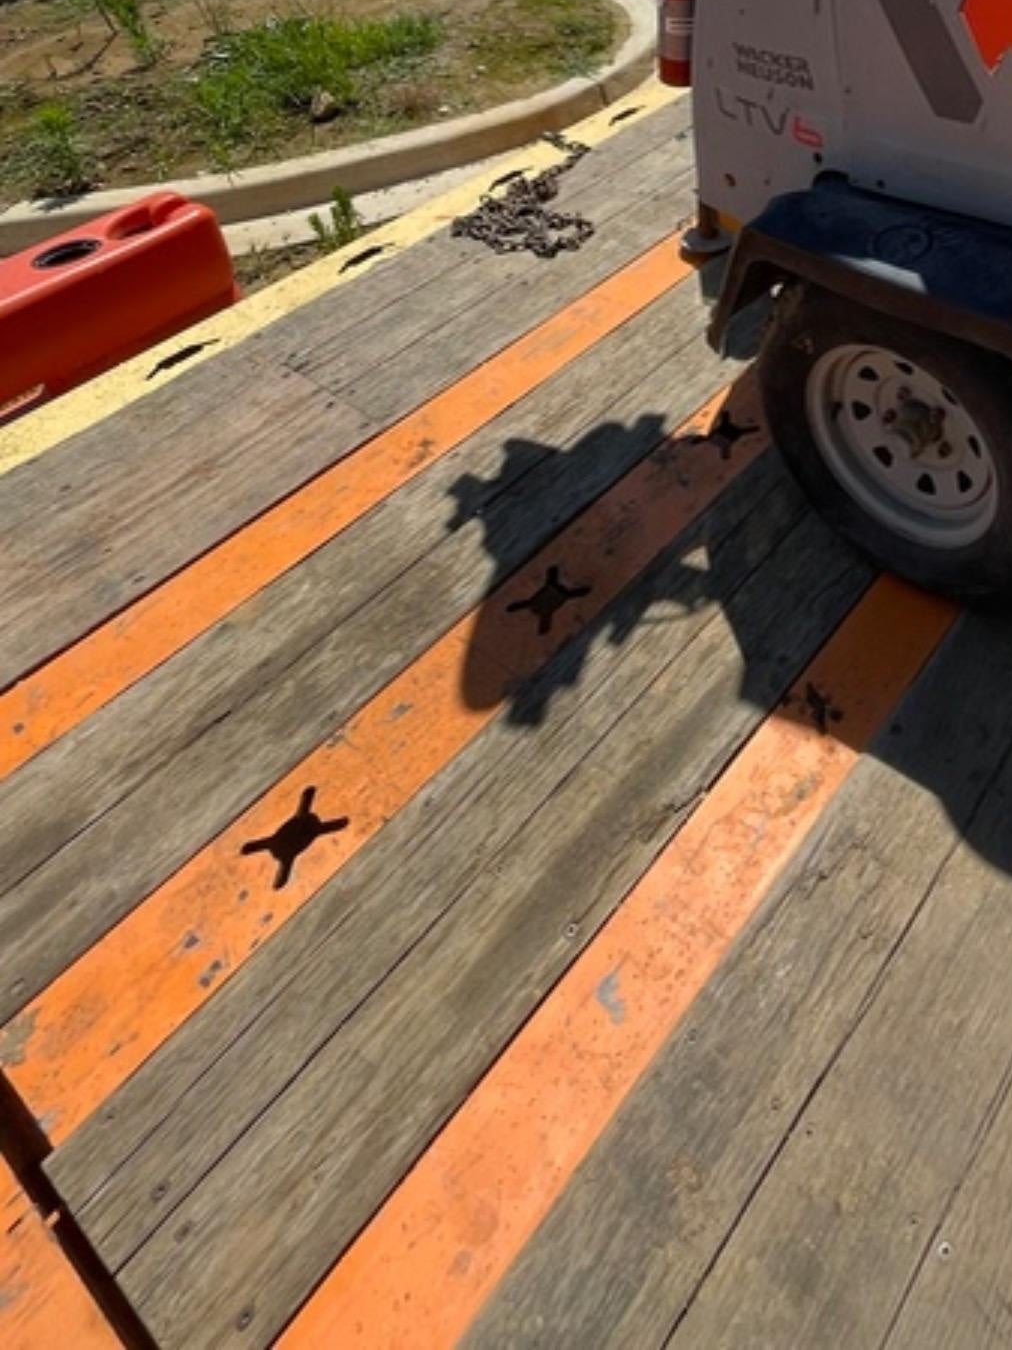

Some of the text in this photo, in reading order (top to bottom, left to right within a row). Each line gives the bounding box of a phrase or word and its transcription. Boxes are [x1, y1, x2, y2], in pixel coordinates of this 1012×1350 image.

[731, 41, 811, 75] WACKER
[736, 61, 815, 91] NEUSON
[714, 87, 826, 150] LTV6
